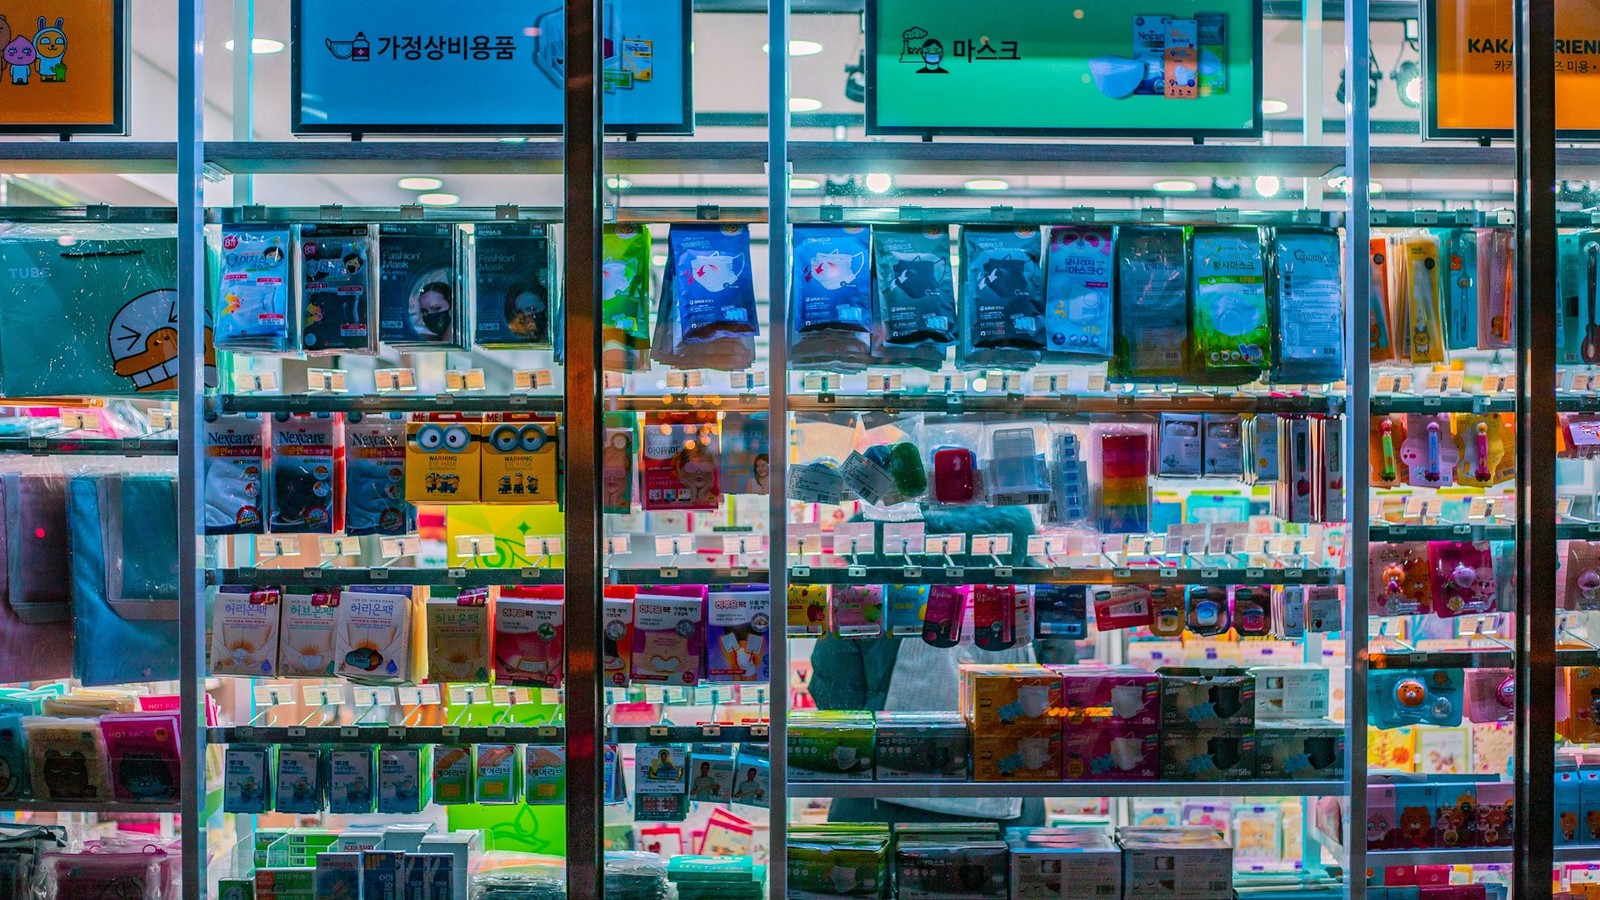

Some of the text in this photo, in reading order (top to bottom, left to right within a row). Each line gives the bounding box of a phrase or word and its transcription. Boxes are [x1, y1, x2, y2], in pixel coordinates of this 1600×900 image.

[377, 35, 517, 61] 가정상비용품
[953, 39, 1021, 64] 마스크
[1468, 38, 1514, 54] KAK
[1568, 61, 1589, 74] 미용
[8, 267, 50, 279] TUBE
[208, 432, 254, 446] Nexcare
[279, 432, 325, 446] Nexcare
[225, 603, 267, 617] 허리온팩
[290, 604, 334, 619] 허브온팩
[350, 602, 394, 617] 허리온팩
[435, 612, 479, 626] 허브온팩
[128, 730, 152, 738] PACK
